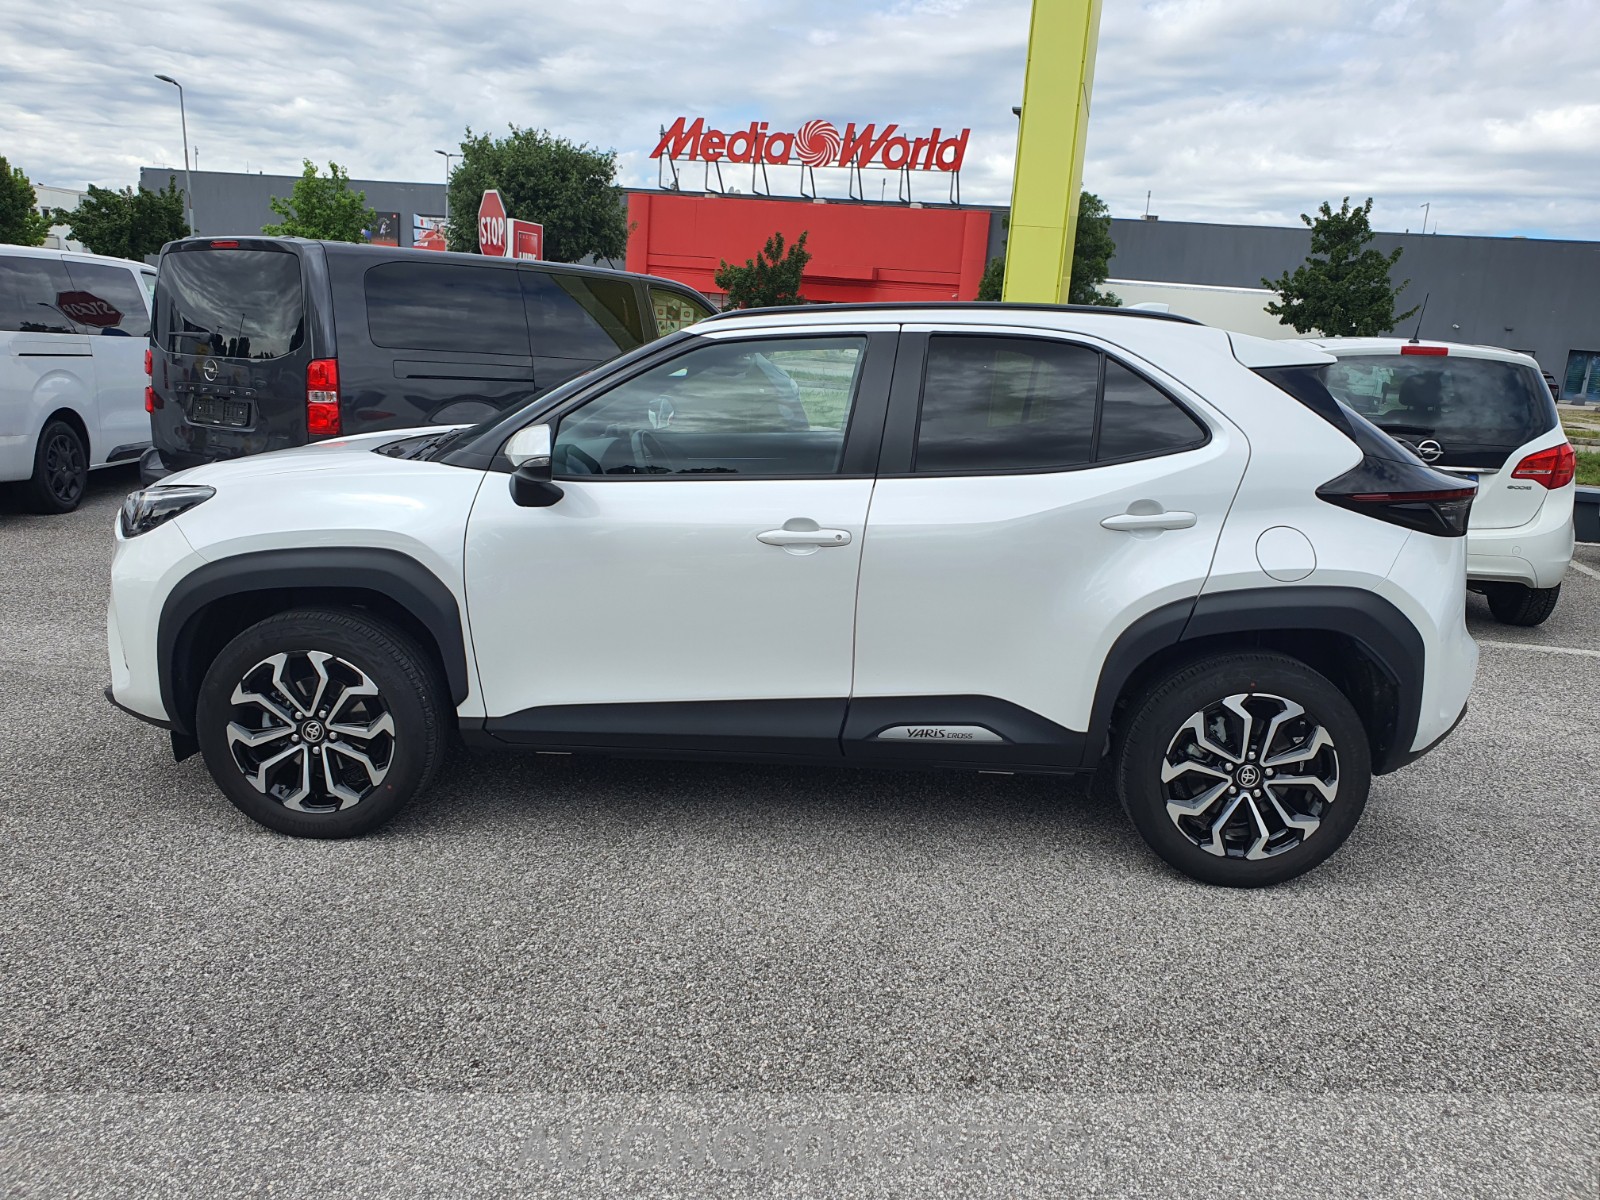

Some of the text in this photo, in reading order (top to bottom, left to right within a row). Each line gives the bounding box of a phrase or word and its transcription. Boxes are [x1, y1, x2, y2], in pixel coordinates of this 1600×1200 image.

[649, 116, 971, 172] Media World
[480, 216, 504, 246] STOP
[946, 732, 973, 740] CROSS
